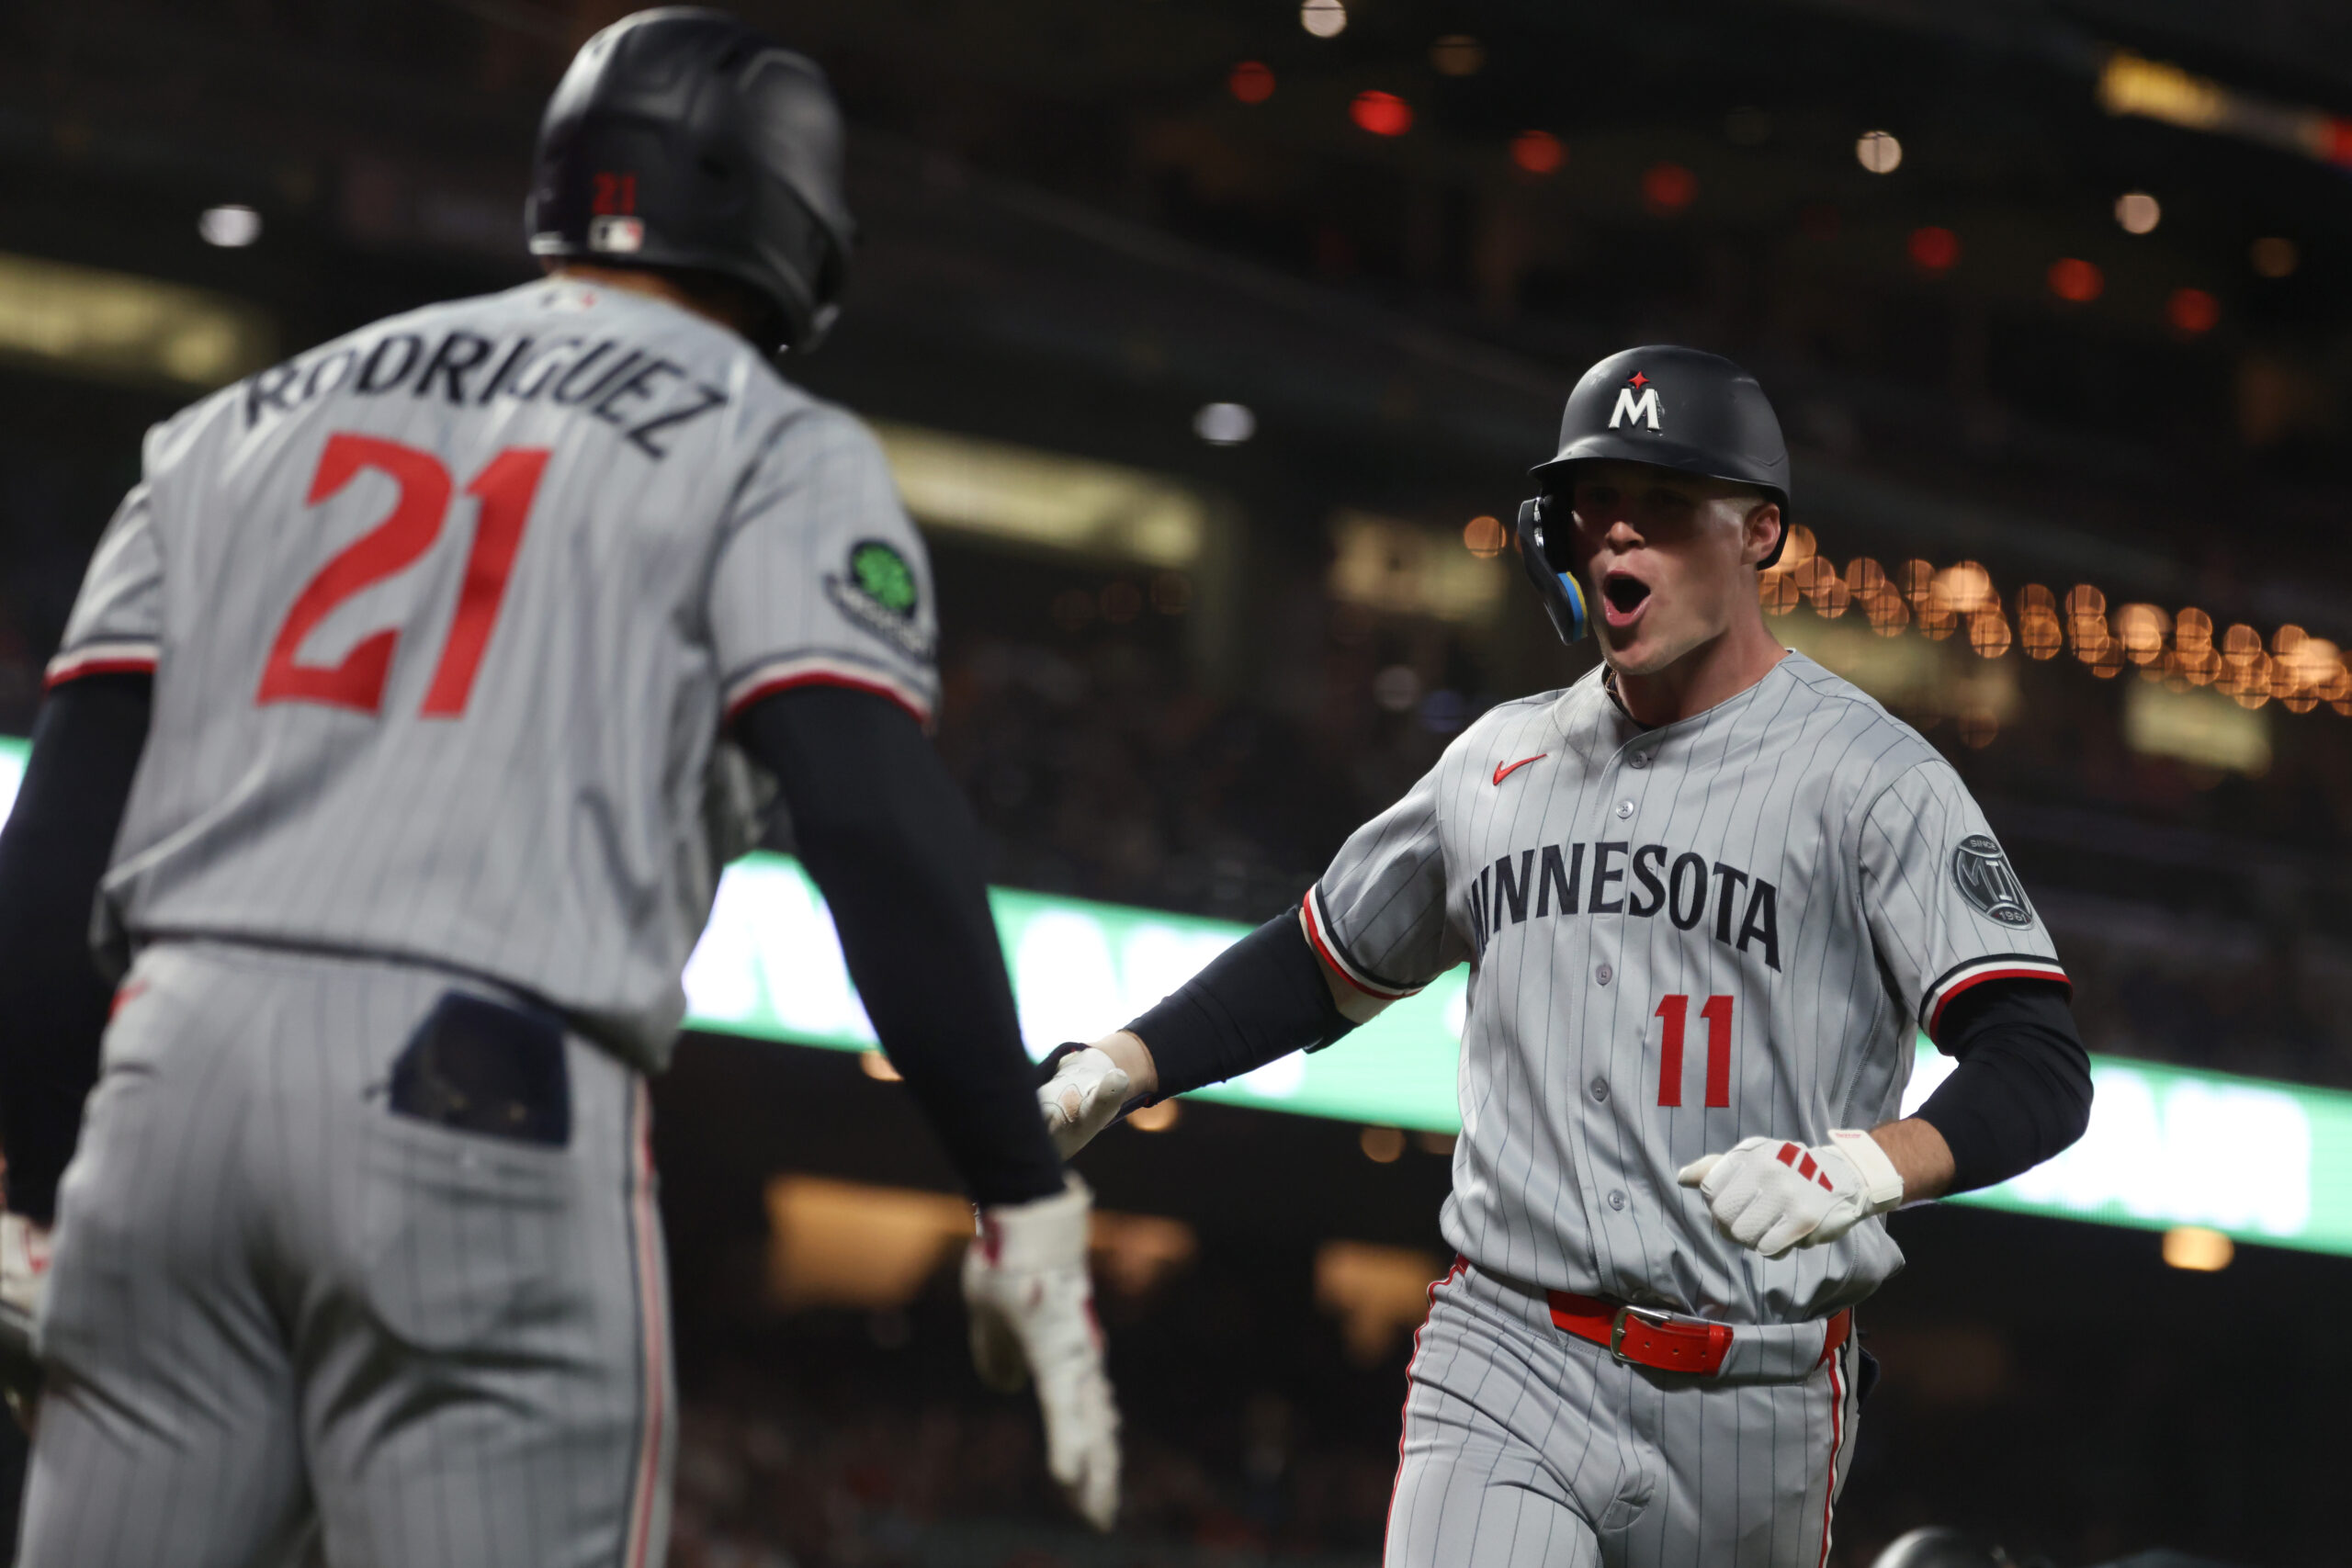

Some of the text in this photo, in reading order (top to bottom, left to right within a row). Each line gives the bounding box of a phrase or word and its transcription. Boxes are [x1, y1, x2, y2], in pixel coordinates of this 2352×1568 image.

[593, 171, 637, 217] 21
[245, 331, 729, 459] RODRIGUEZ
[1608, 388, 1660, 430] M
[255, 432, 554, 719] 21
[1969, 840, 1997, 851] SINCE
[1999, 911, 2029, 923] 1961
[1655, 994, 1735, 1108] 11
